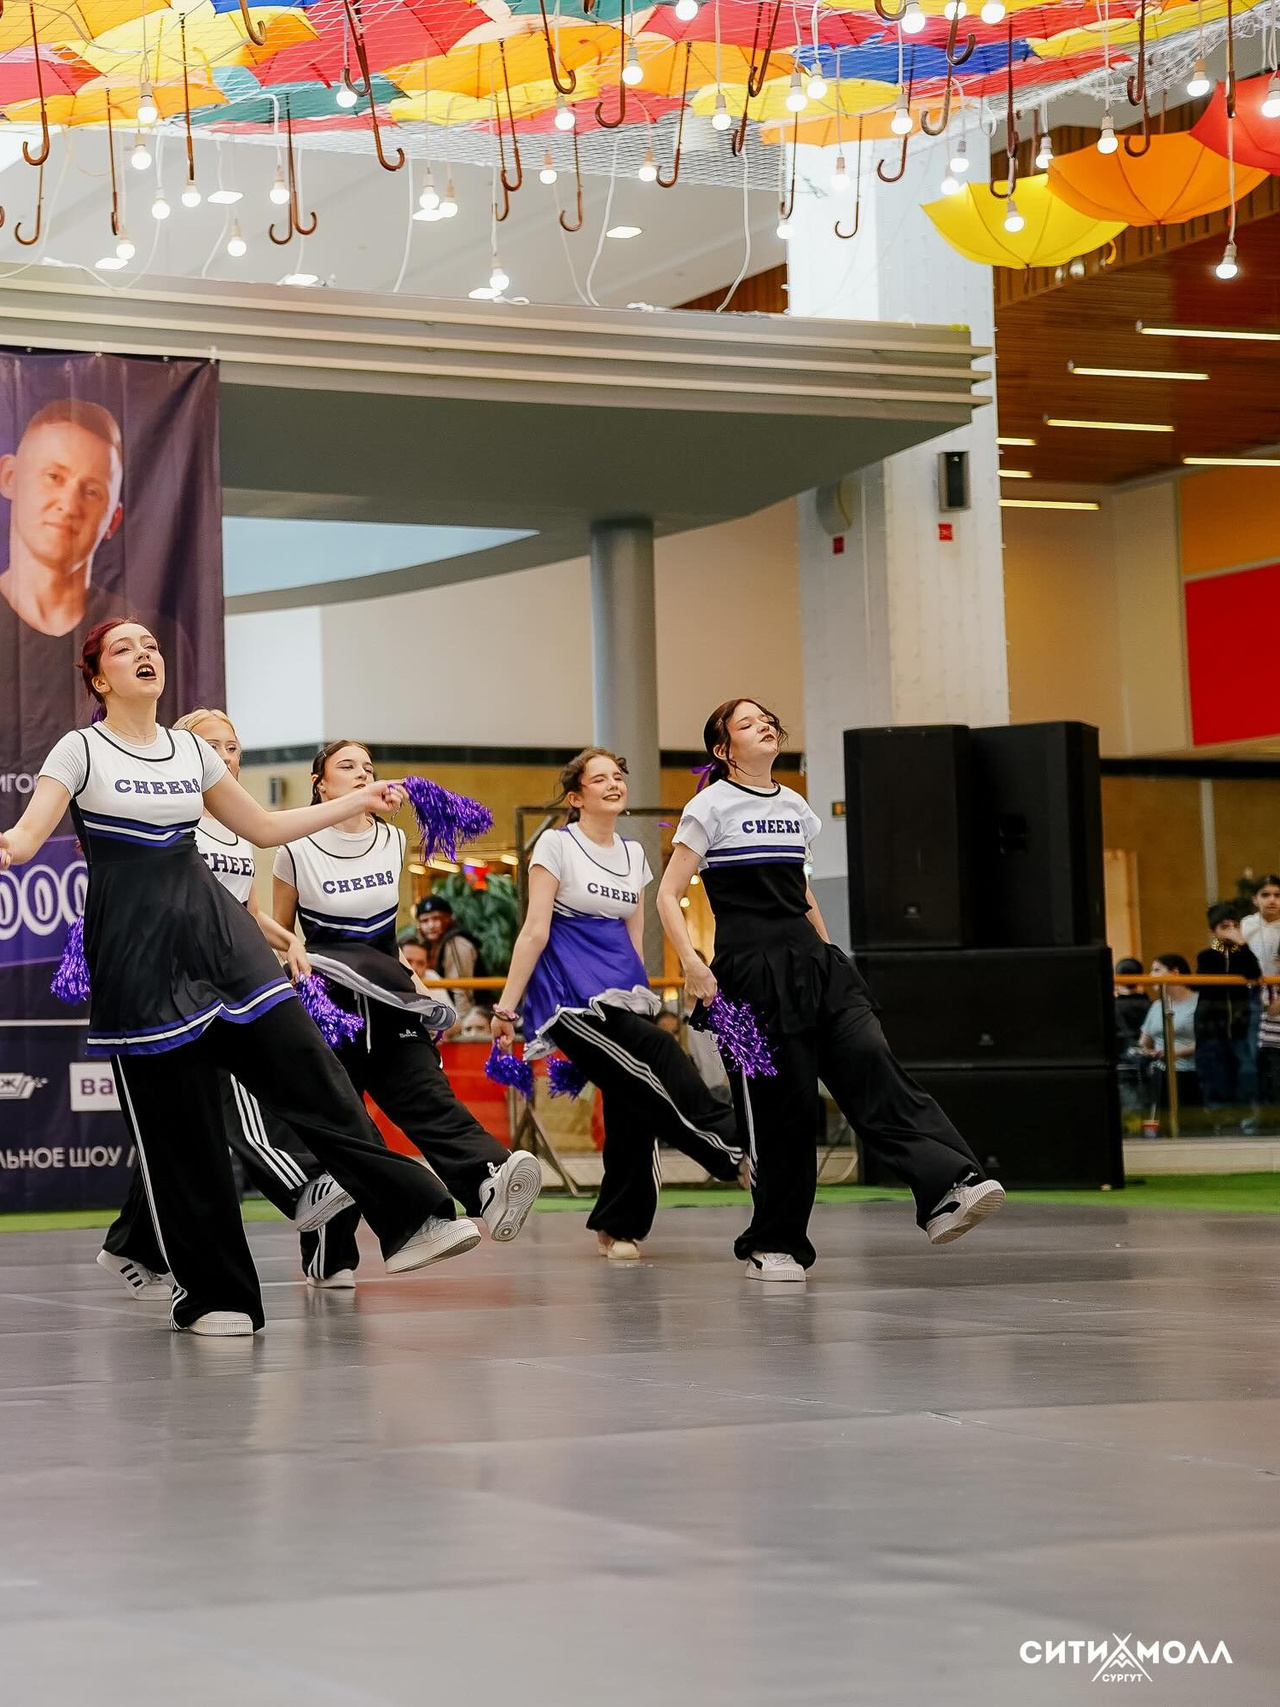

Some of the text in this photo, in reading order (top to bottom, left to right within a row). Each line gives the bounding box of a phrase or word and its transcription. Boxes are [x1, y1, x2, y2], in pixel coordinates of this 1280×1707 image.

[114, 779, 202, 796] CHEERS
[742, 819, 801, 834] CHEERS
[323, 870, 394, 894] CHEERS
[587, 882, 640, 904] CHEER
[70, 1146, 124, 1169] ШОУ
